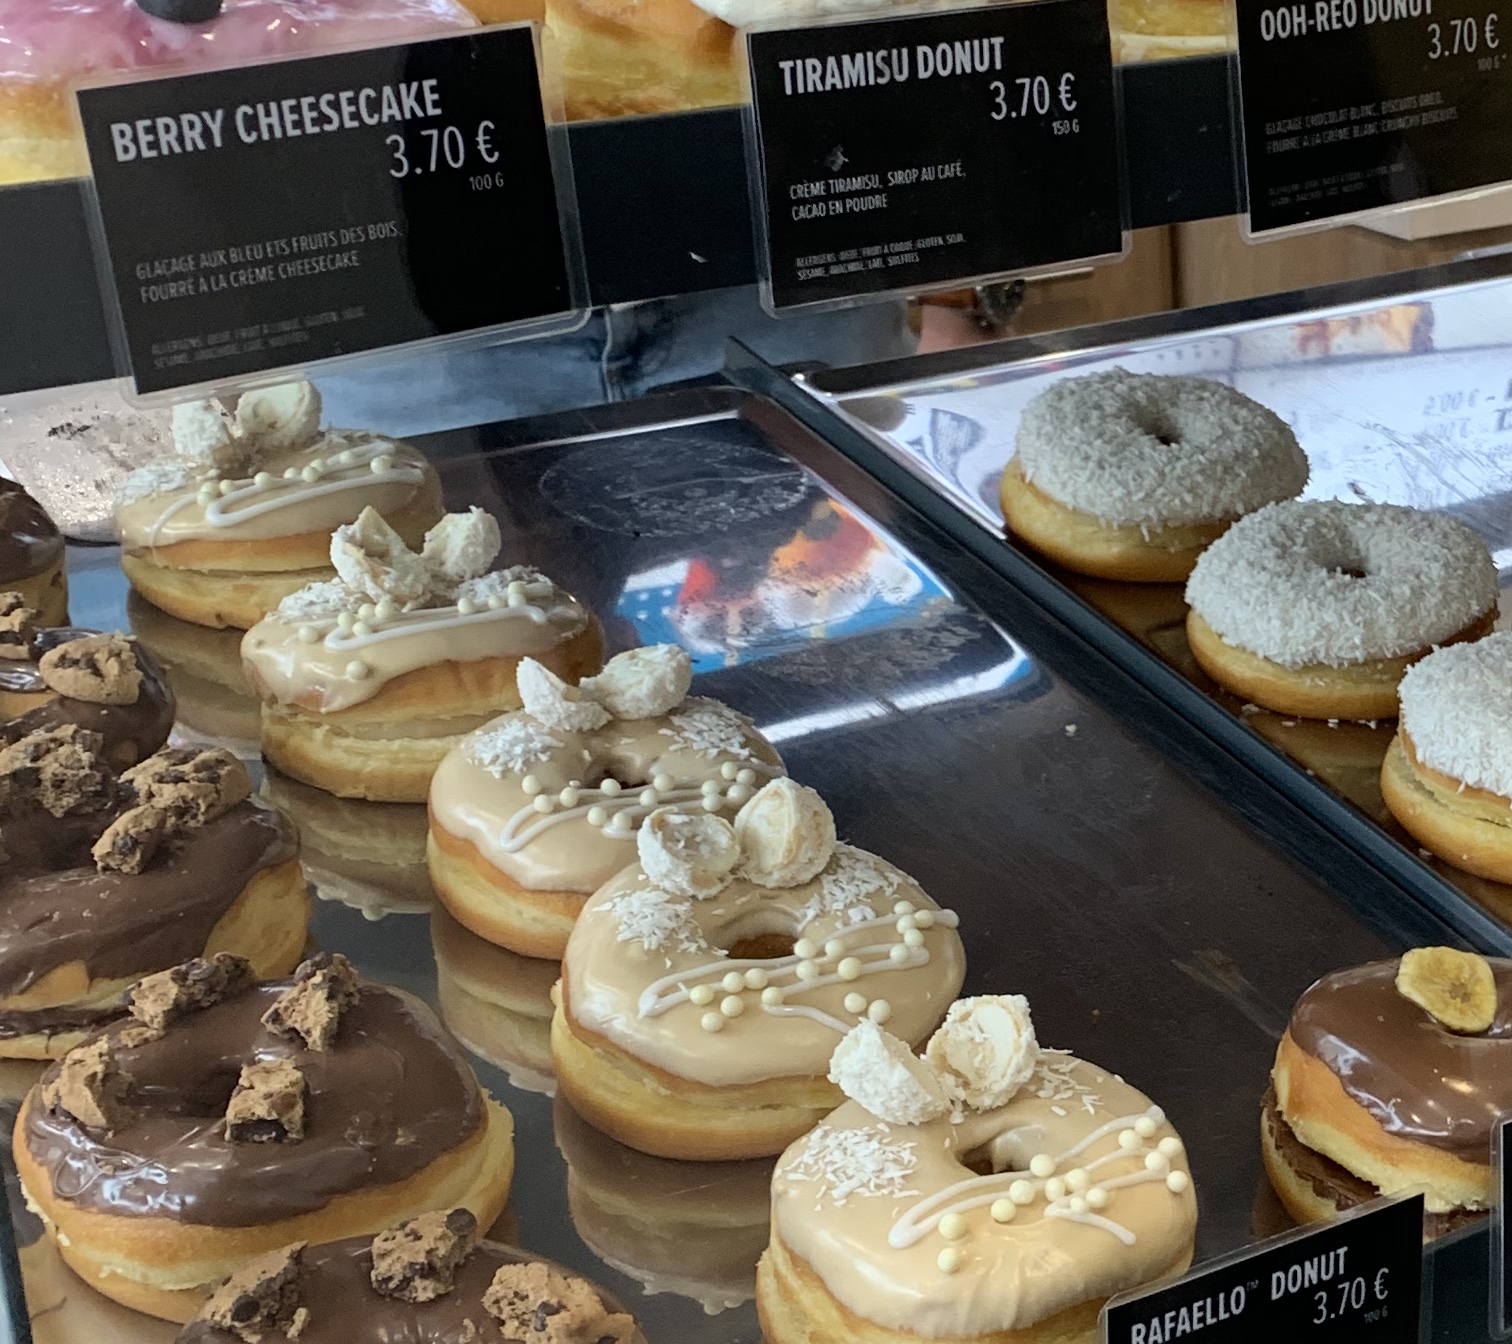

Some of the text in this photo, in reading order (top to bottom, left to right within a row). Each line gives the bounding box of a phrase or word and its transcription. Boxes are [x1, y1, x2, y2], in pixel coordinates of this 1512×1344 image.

[1426, 12, 1499, 60] 3.70 €
[778, 35, 1006, 97] TIRAMISU DONUT
[109, 75, 443, 164] BERRY CHEESECAKE
[988, 71, 1077, 121] 3.70 €
[384, 118, 501, 179] 3.70 €
[469, 171, 504, 192] 100 G
[886, 167, 919, 187] SIROP
[920, 165, 936, 182] AU
[791, 192, 888, 221] CACAO EN POUDRE
[339, 224, 366, 247] DES
[208, 270, 228, 293] LA
[277, 247, 361, 281] CHEESECAKE
[1270, 1244, 1348, 1302] DONUT
[1313, 1265, 1389, 1326] 3.70 €
